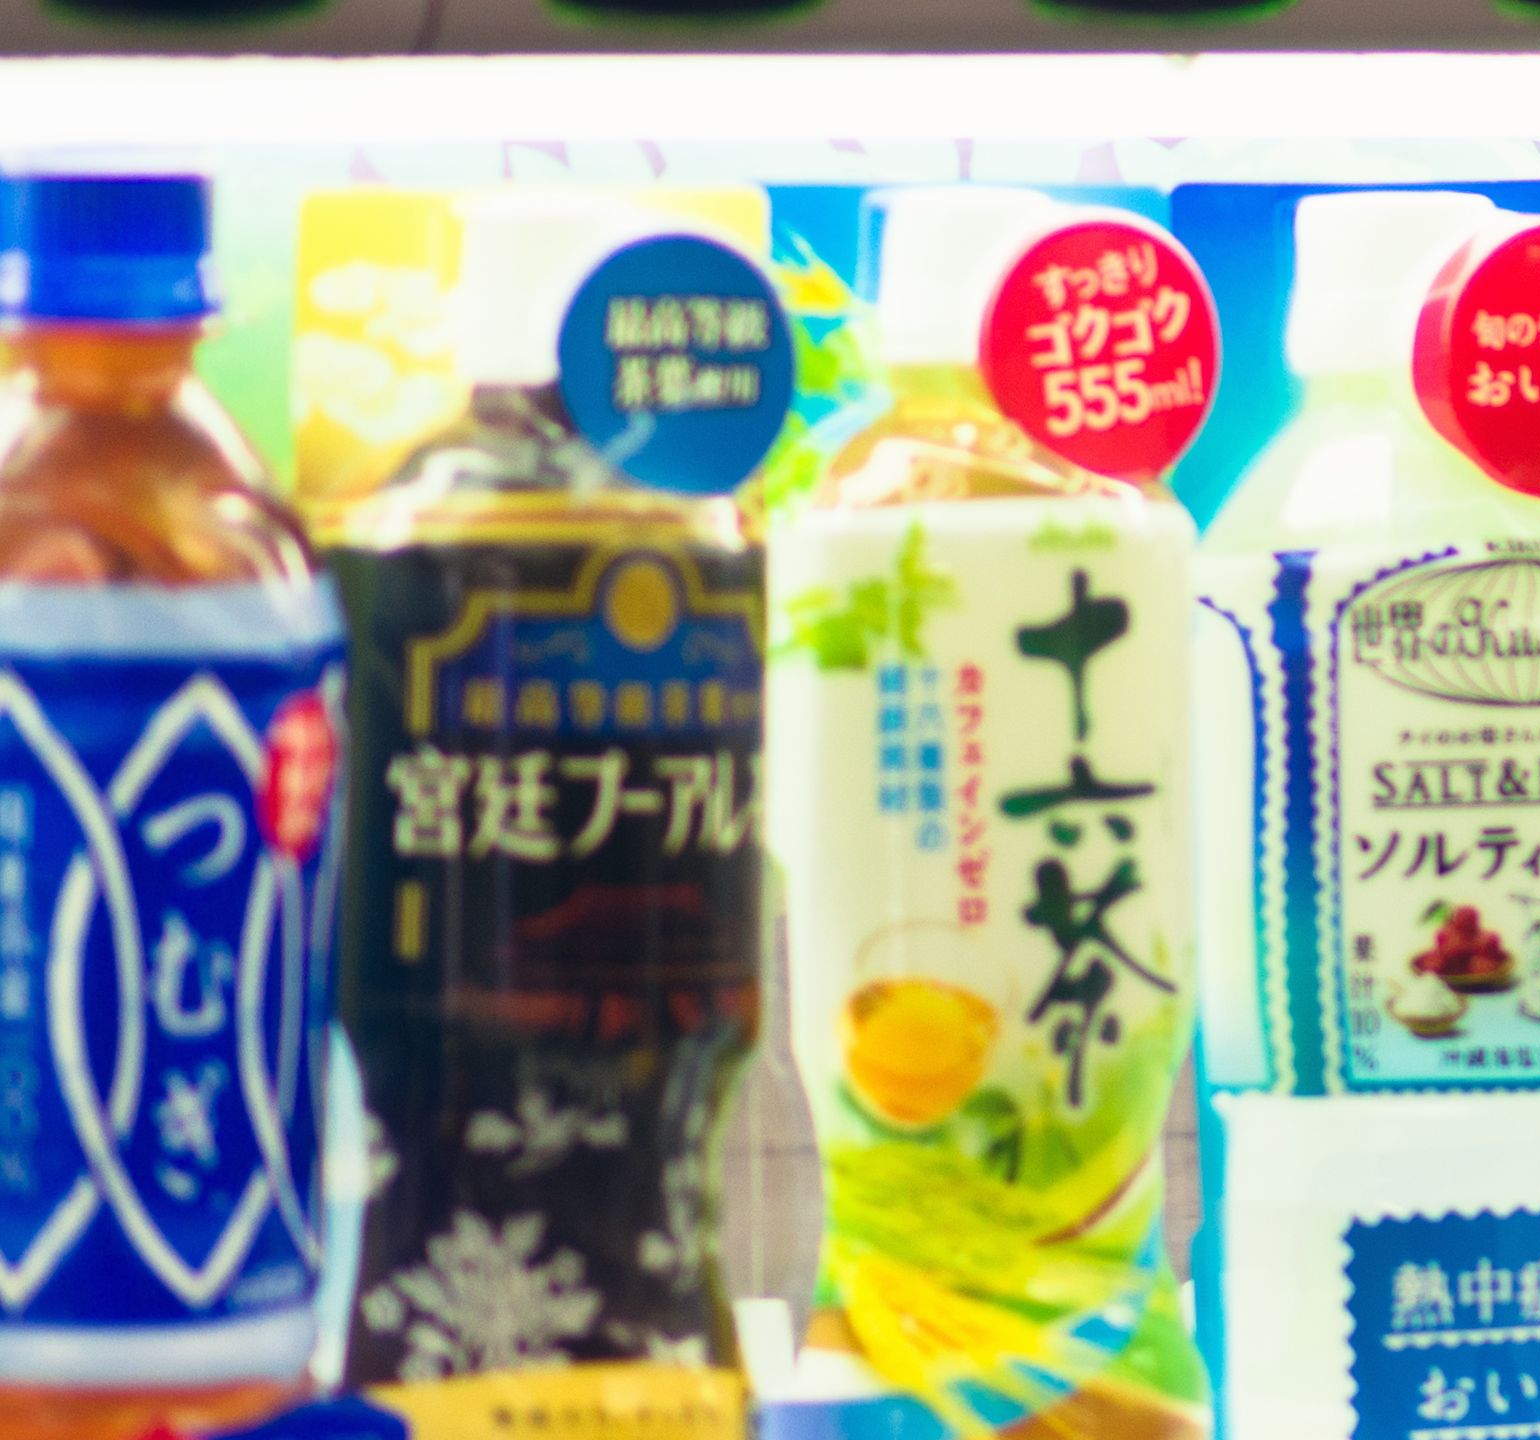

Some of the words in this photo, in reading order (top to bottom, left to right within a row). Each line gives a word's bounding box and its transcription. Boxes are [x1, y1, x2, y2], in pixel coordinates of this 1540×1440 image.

[1032, 243, 1160, 309] すっきり
[1025, 287, 1192, 370] ゴクゴク
[997, 566, 1179, 1109] 十六茶
